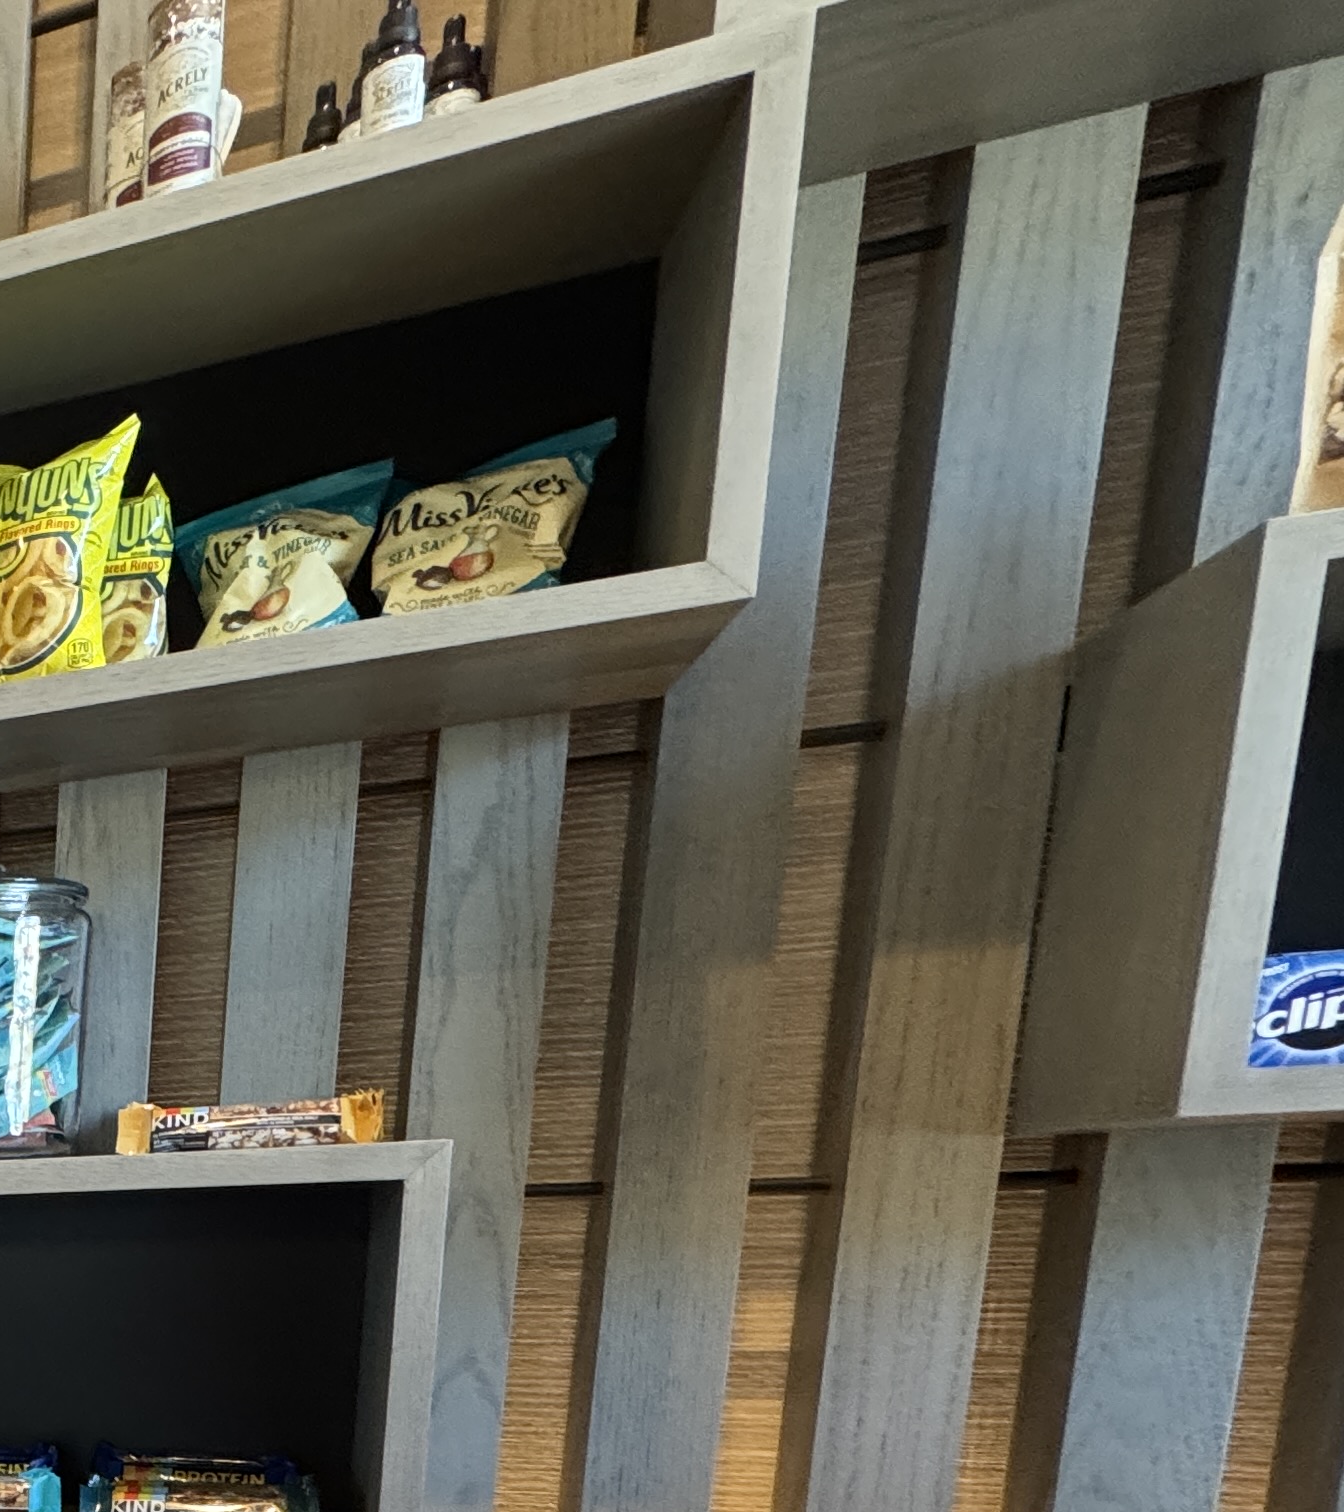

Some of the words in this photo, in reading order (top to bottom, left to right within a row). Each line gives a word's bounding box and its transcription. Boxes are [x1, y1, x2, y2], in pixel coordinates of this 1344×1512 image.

[157, 67, 209, 104] ACRELY
[45, 518, 76, 531] Rings
[376, 504, 463, 546] Miss
[129, 558, 160, 573] Rings
[387, 545, 415, 567] SEA
[1255, 992, 1344, 1038] clip
[152, 1112, 210, 1132] KIND
